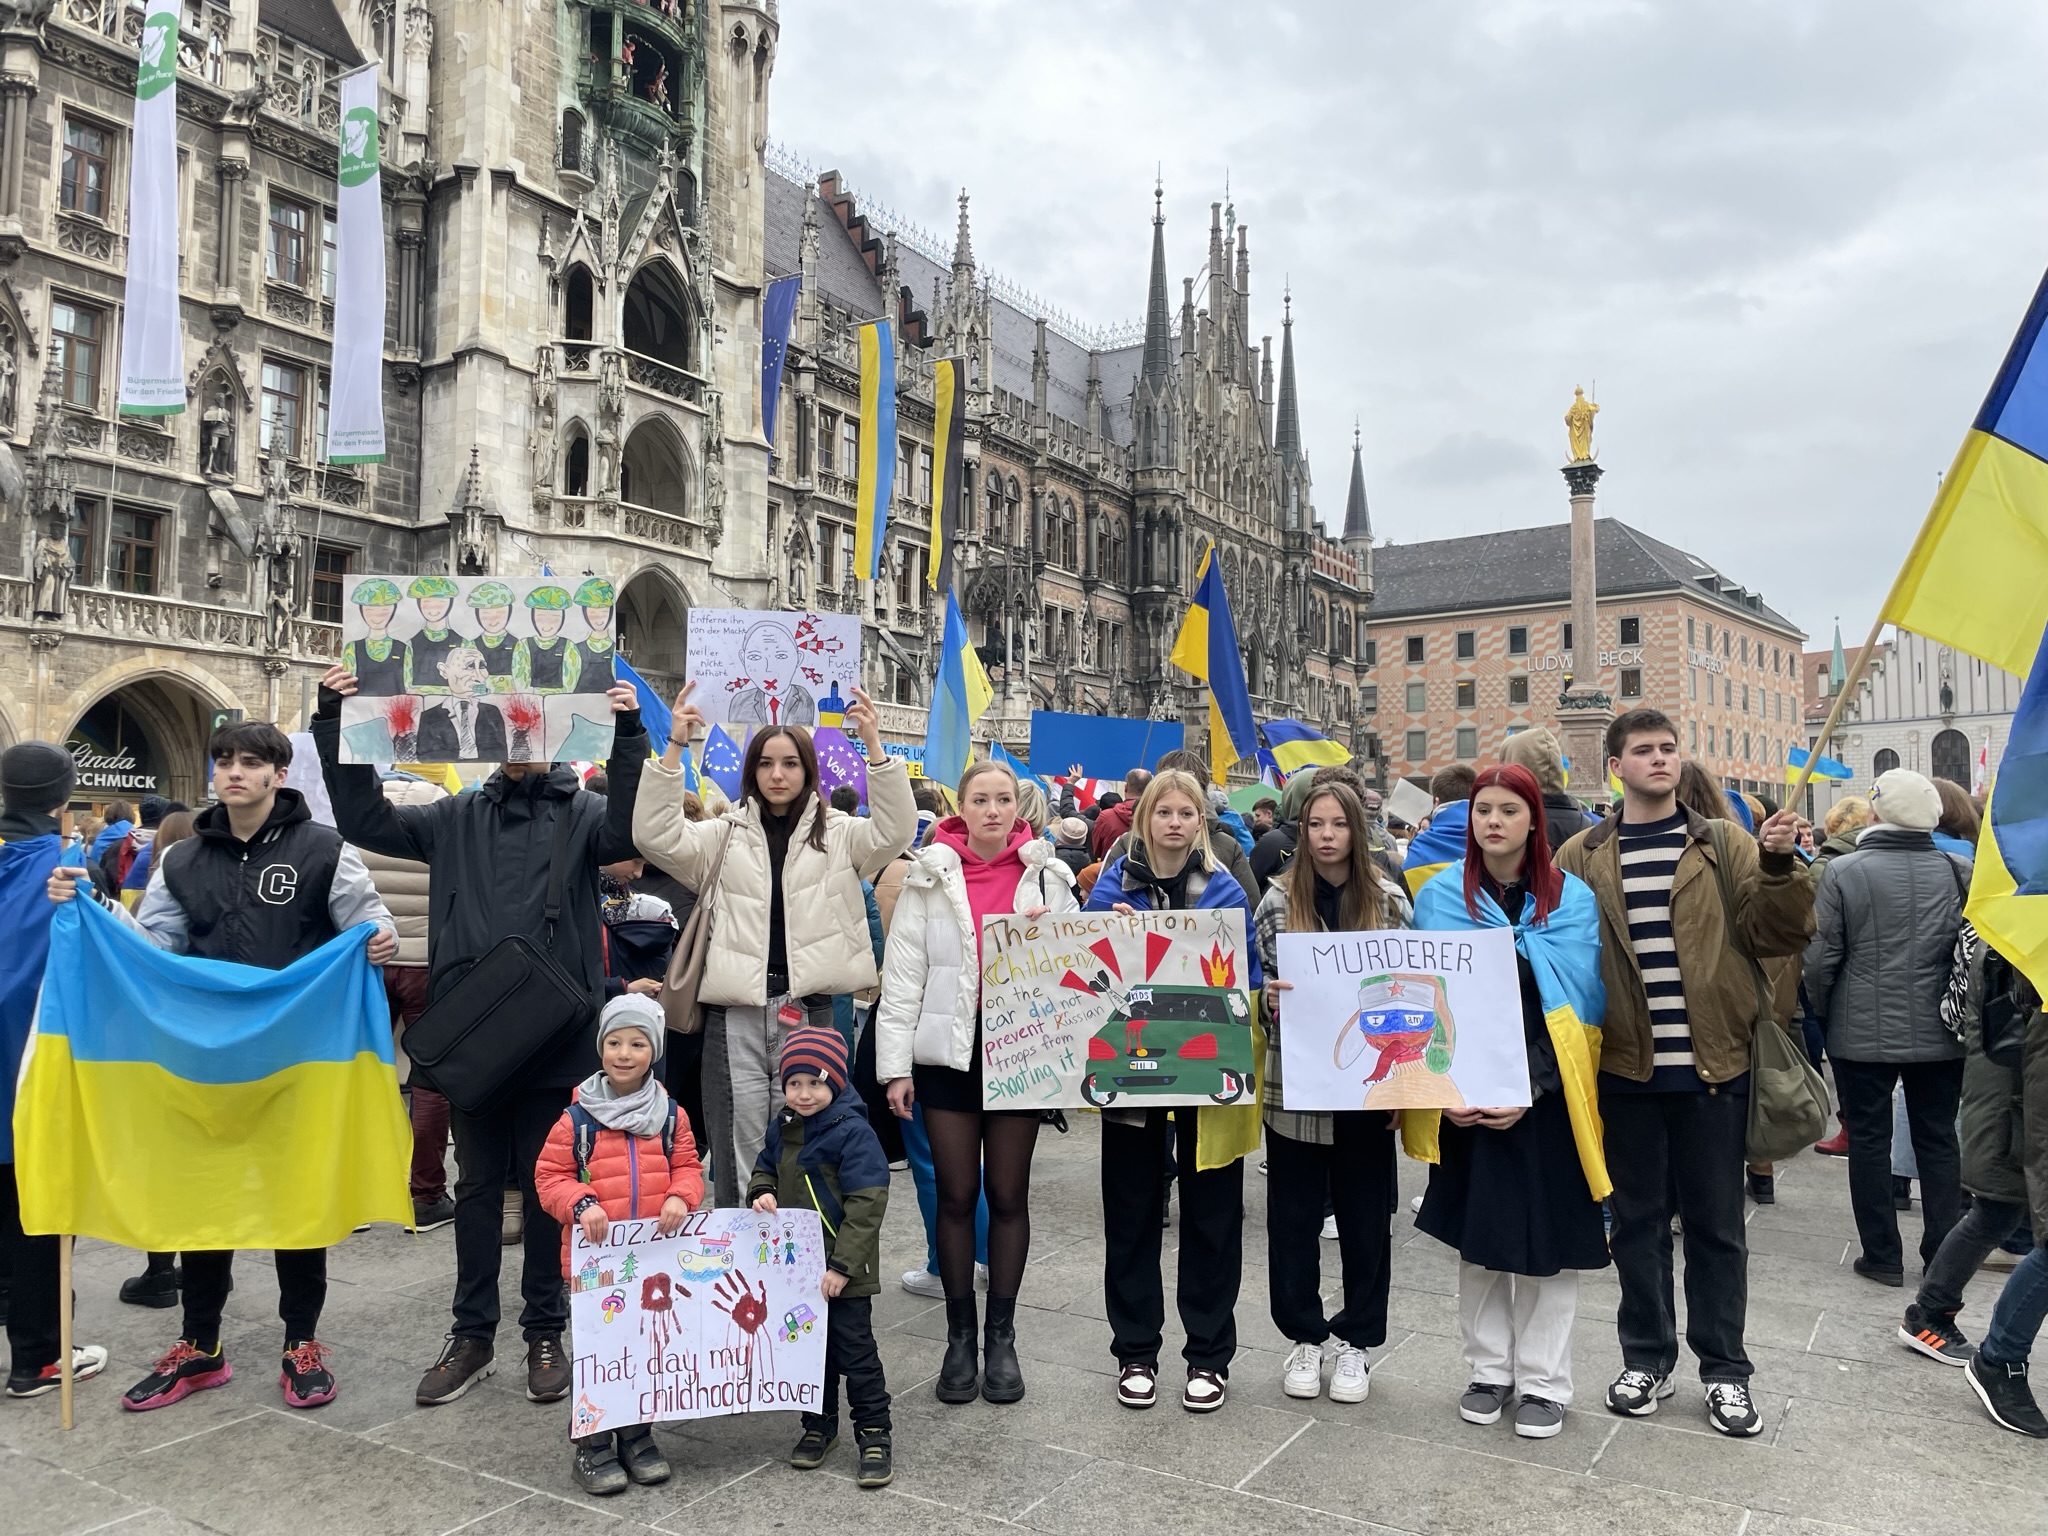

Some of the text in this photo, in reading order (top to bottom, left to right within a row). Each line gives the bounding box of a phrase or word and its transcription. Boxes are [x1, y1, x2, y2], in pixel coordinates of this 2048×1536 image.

[156, 70, 172, 79] Peace
[360, 160, 376, 169] Peace
[127, 376, 182, 385] Bürgermeister
[690, 610, 744, 624] Entferne ihn
[724, 627, 747, 635] Macht
[700, 659, 723, 668] nicht
[828, 656, 860, 669] Fuck
[1527, 649, 1645, 672] LUDW BECK
[838, 670, 854, 683] off
[64, 740, 136, 770] Linda
[914, 749, 926, 760] UK
[826, 756, 846, 780] Volt
[258, 864, 298, 904] C
[984, 912, 1198, 953] The inscription
[1312, 938, 1473, 974] MURDERER
[986, 984, 1044, 1009] on the
[986, 1008, 1016, 1032] car
[1029, 996, 1057, 1018] did
[1060, 990, 1082, 1010] not
[1372, 1014, 1422, 1025] I am
[985, 1019, 1045, 1068] prevent
[995, 1034, 1074, 1072] troops from
[987, 1046, 1076, 1103] shooting it
[573, 1340, 751, 1389] That day my
[638, 1372, 820, 1416] childhood is over
